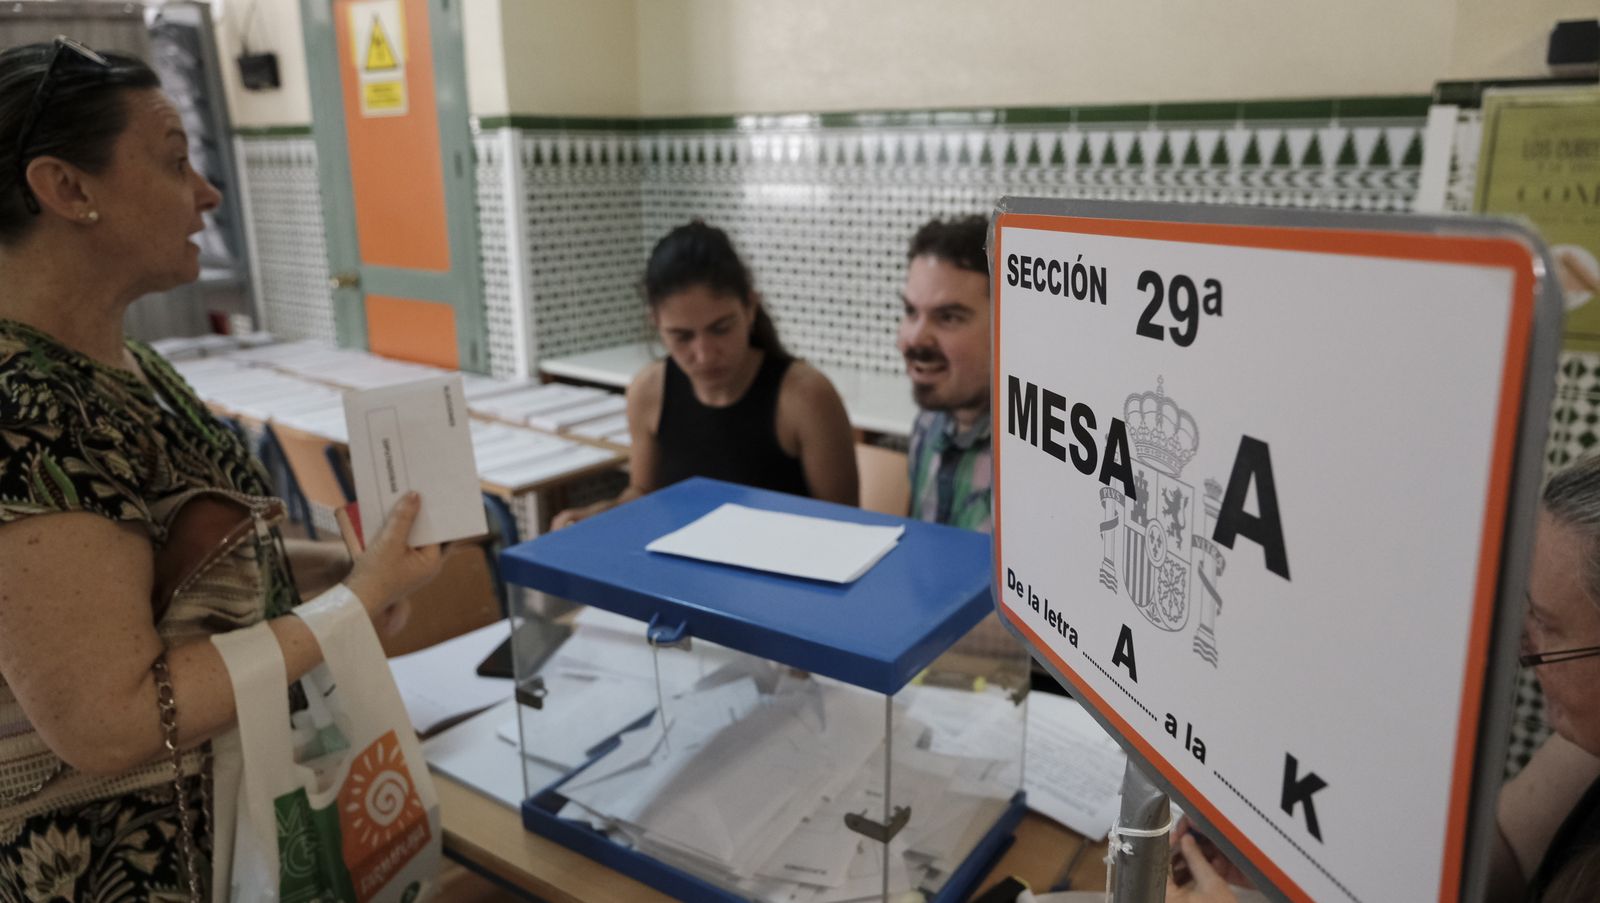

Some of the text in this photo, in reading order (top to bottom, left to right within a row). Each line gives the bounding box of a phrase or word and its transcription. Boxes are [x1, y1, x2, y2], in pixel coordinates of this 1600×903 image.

[1007, 253, 1223, 348] SECCIÓN 29ª
[1008, 374, 1292, 582] MESA A
[1007, 566, 1329, 844] De la letra A a la K
